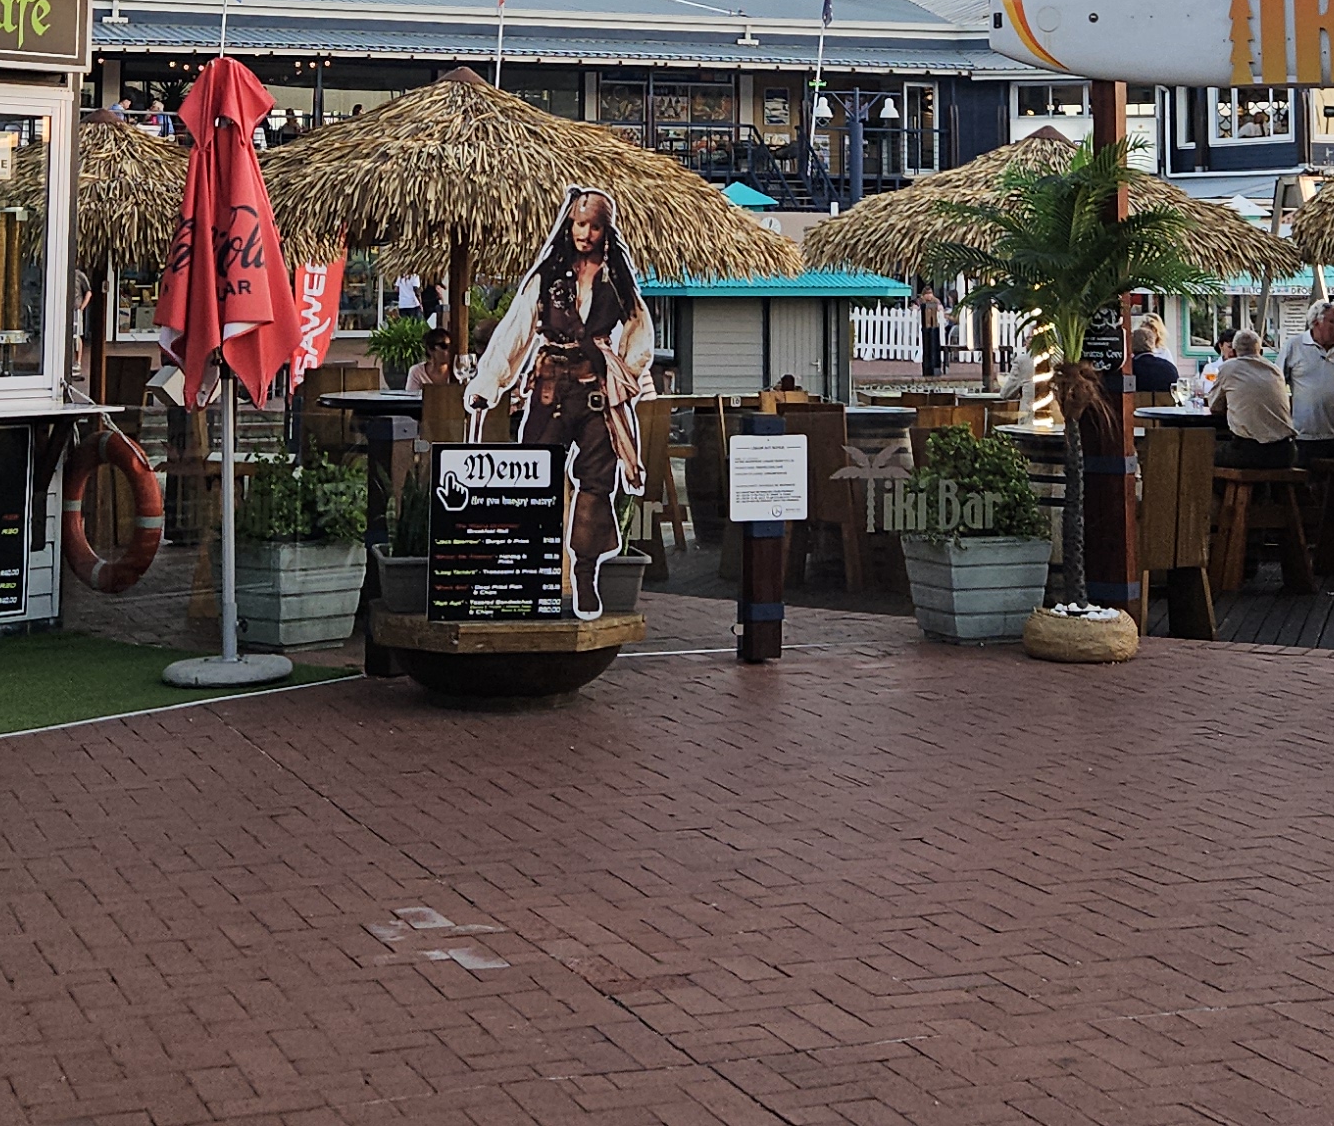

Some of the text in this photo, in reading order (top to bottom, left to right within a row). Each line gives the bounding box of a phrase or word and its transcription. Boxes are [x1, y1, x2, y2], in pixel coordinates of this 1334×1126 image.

[1242, 286, 1275, 294] BILTOG
[464, 452, 540, 487] Menu
[629, 499, 664, 540] ar
[938, 478, 1005, 530] Bar
